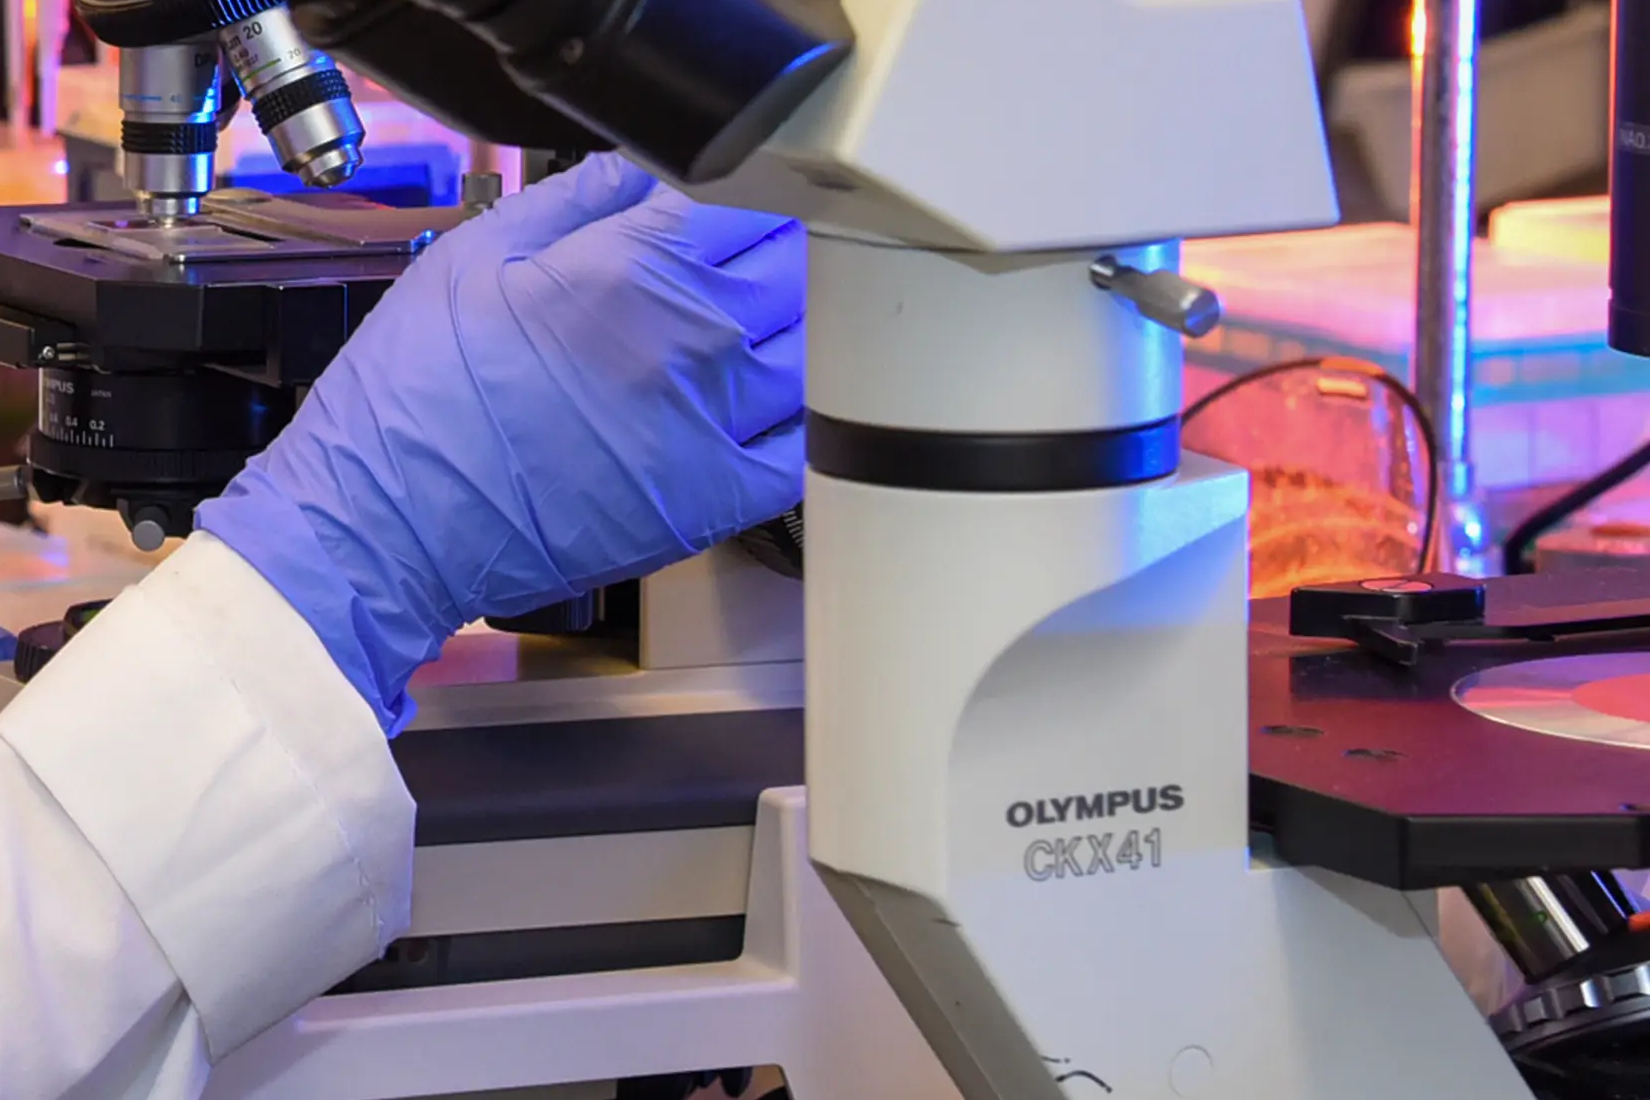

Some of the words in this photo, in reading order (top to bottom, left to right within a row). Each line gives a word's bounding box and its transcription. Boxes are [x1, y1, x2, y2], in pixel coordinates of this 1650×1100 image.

[243, 21, 263, 41] 20
[89, 419, 106, 431] 0.2
[1005, 784, 1185, 828] OLYMPUS
[1023, 827, 1162, 882] CKX41
